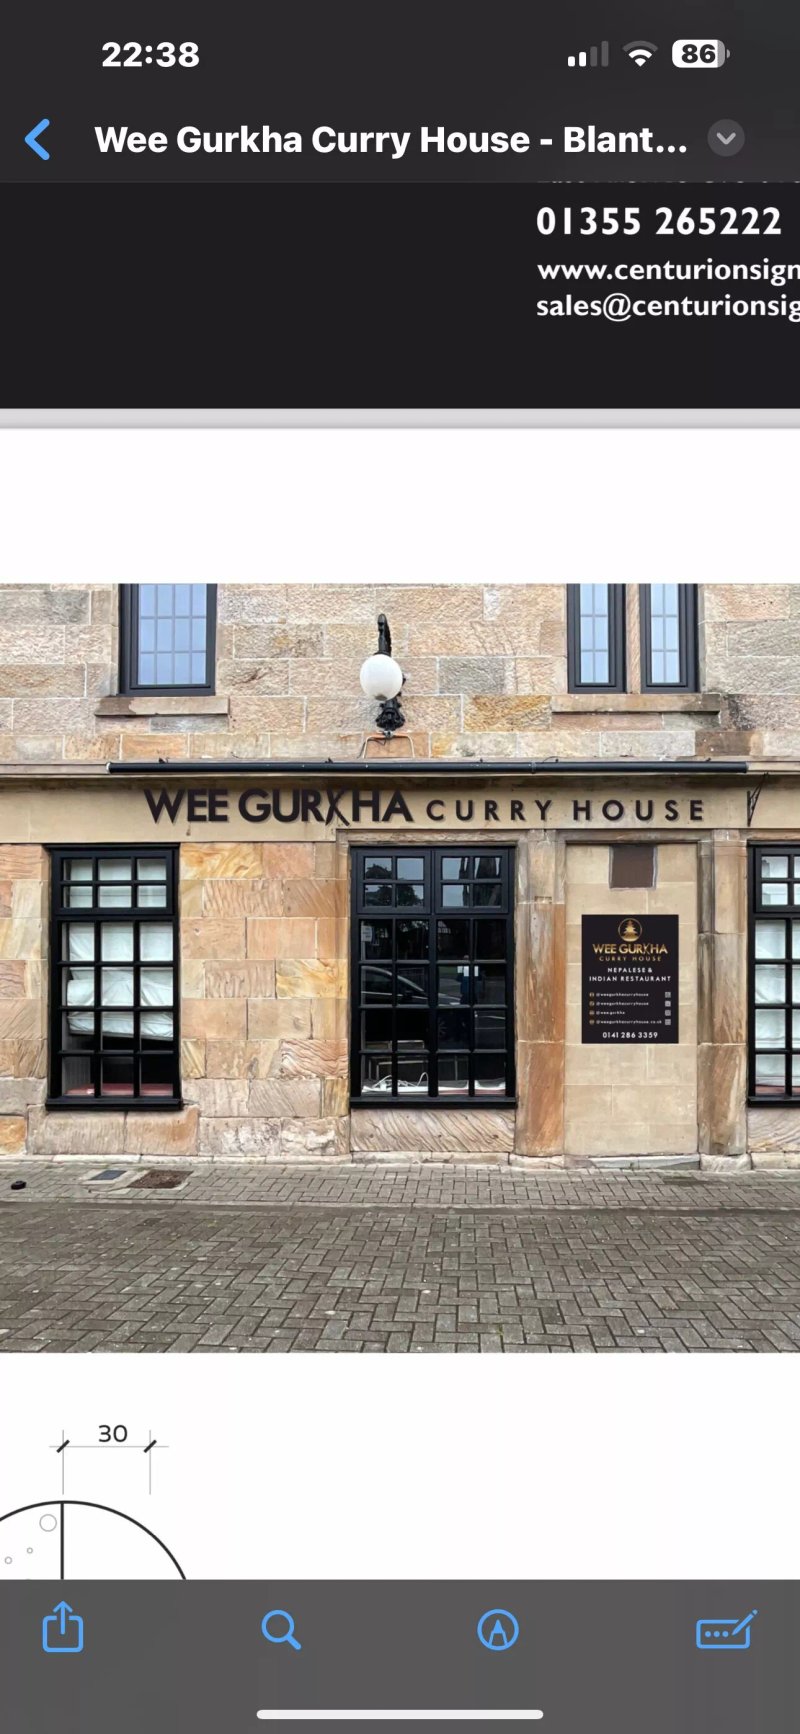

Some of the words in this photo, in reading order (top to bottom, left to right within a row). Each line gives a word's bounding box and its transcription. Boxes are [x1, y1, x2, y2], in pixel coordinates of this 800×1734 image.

[101, 41, 200, 68] 22:38
[681, 44, 716, 64] 86
[95, 126, 168, 153] Wee
[177, 125, 303, 153] Gurkha
[311, 125, 411, 159] Curry
[420, 126, 530, 153] House
[564, 125, 688, 153] Blant...
[537, 207, 641, 235] 01355
[655, 207, 782, 235] 265222
[538, 257, 800, 286] www.centurionsign
[537, 292, 800, 322] sales@centurionsig
[143, 788, 229, 823] WEE
[238, 788, 414, 826] GURKHA
[426, 799, 552, 822] CURRY
[573, 799, 705, 822] HOUSE
[592, 943, 617, 954] WEE
[619, 943, 668, 955] GURKHA
[98, 1425, 128, 1443] 30
